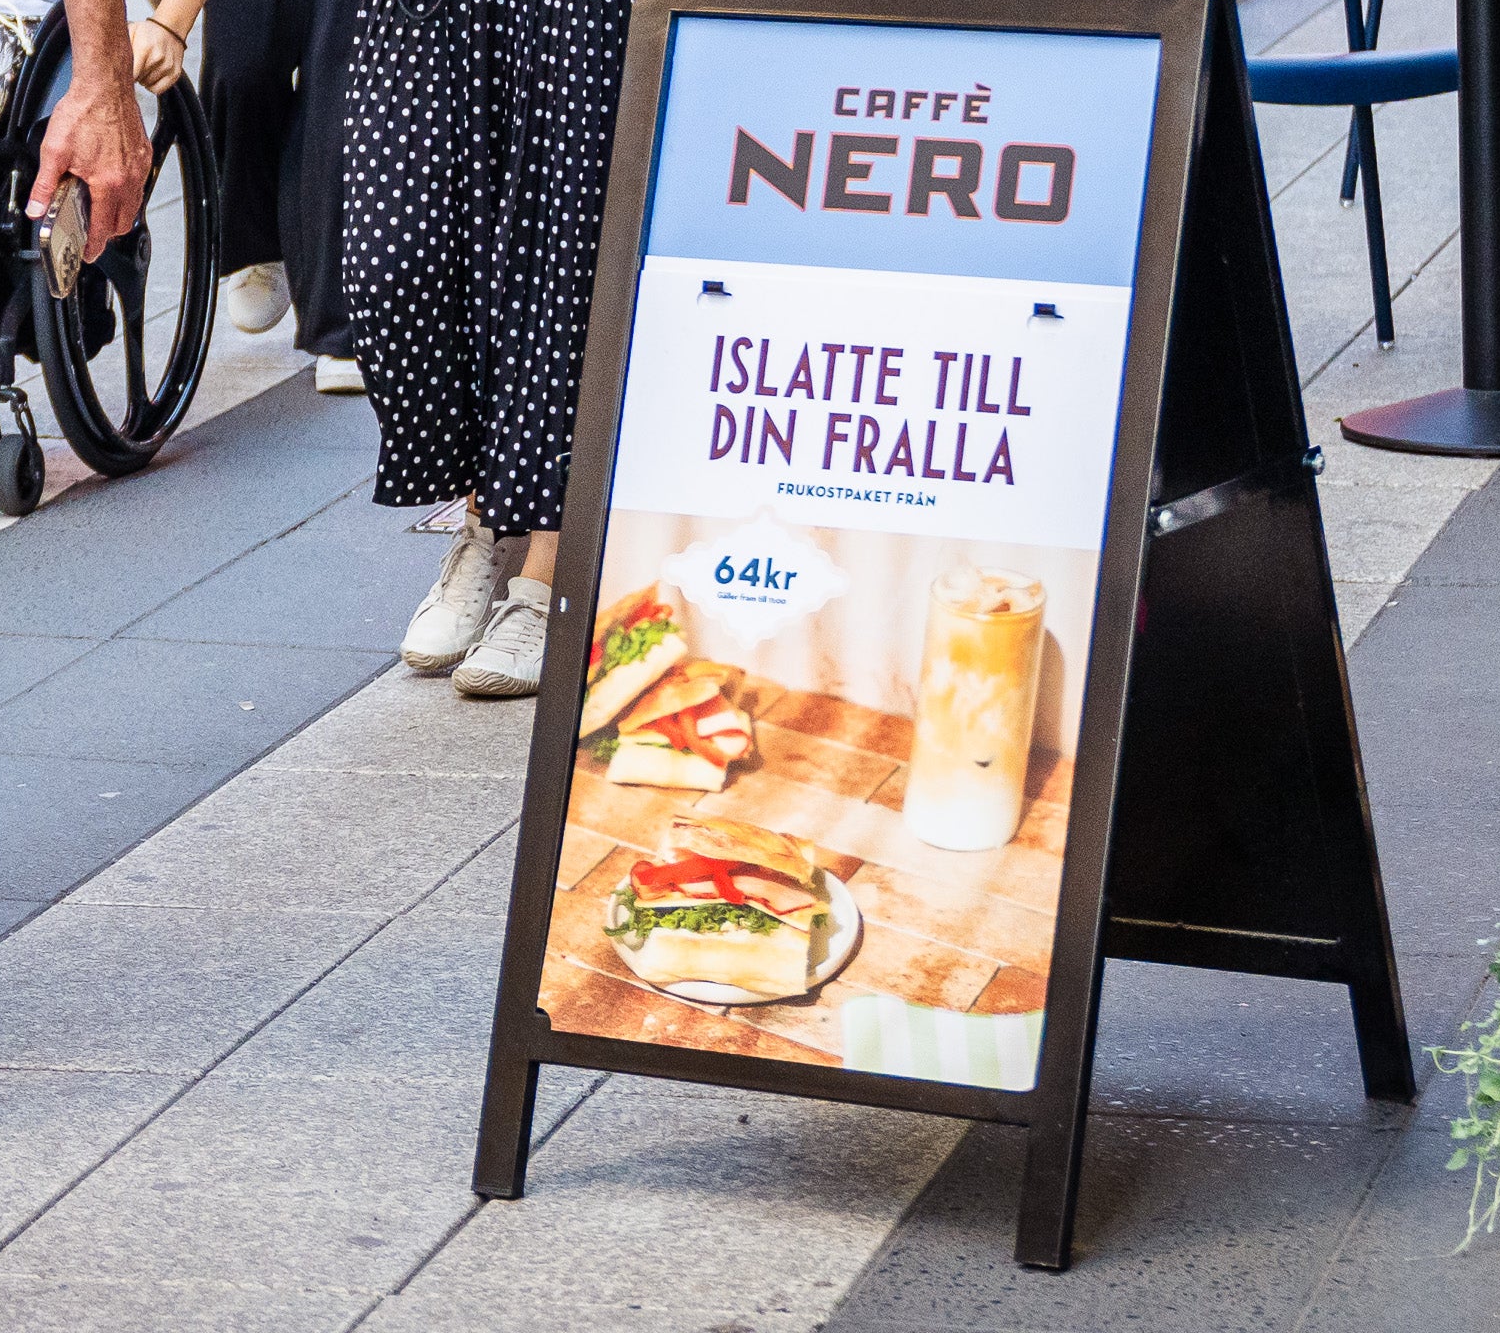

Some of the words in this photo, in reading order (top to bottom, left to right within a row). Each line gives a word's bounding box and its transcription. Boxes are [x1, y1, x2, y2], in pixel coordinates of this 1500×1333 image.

[834, 82, 992, 123] CAFFÈ
[726, 125, 1077, 225] NERO
[710, 335, 904, 406] ISLATTE
[933, 351, 1031, 416] TILL
[709, 403, 798, 467] DIN
[822, 412, 1015, 485] FRALLA
[777, 483, 892, 503] FRUKOSTPAKET
[896, 492, 937, 506] FRÅN
[714, 556, 798, 590] 64kr
